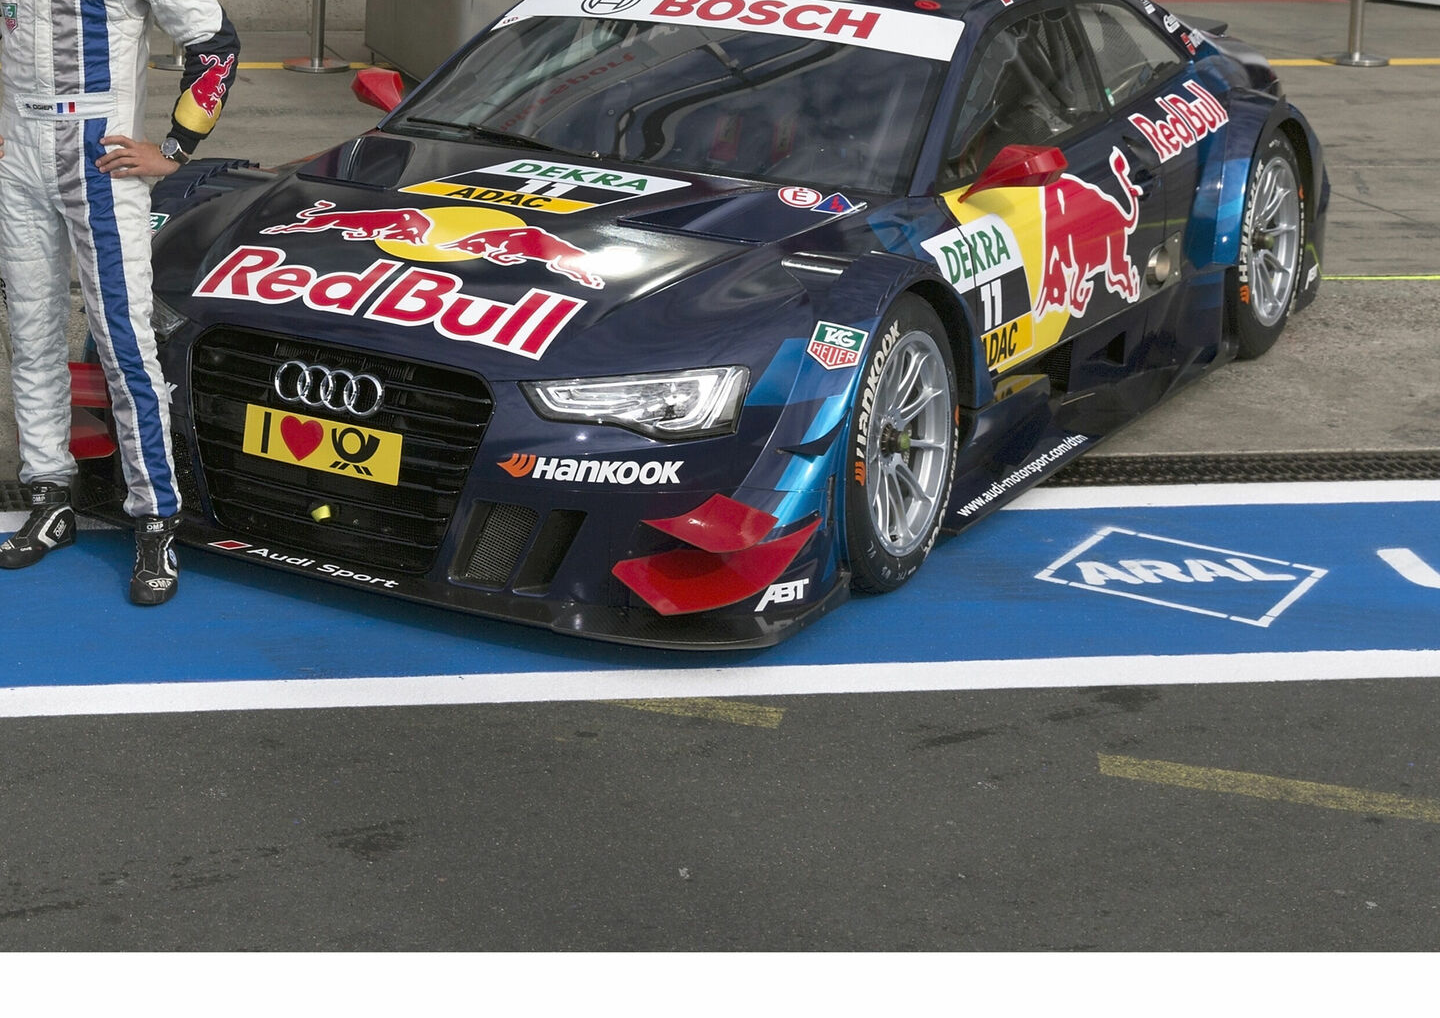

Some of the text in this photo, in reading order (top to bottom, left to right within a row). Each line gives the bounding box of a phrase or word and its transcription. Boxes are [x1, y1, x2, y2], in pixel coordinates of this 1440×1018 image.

[1130, 80, 1230, 163] Red Bull
[448, 184, 552, 209] ADAC
[505, 161, 650, 193] DEKRA
[940, 224, 1011, 285] DEKRA
[198, 246, 580, 356] Red Bull
[980, 278, 1003, 332] 11
[812, 344, 858, 365] HEUER
[824, 326, 857, 348] TAG
[957, 433, 1089, 518] www.audi-motorsport.com/dtm
[247, 545, 400, 590] Audi Sport
[1076, 557, 1296, 586] ARAL
[754, 577, 810, 613] ABT
